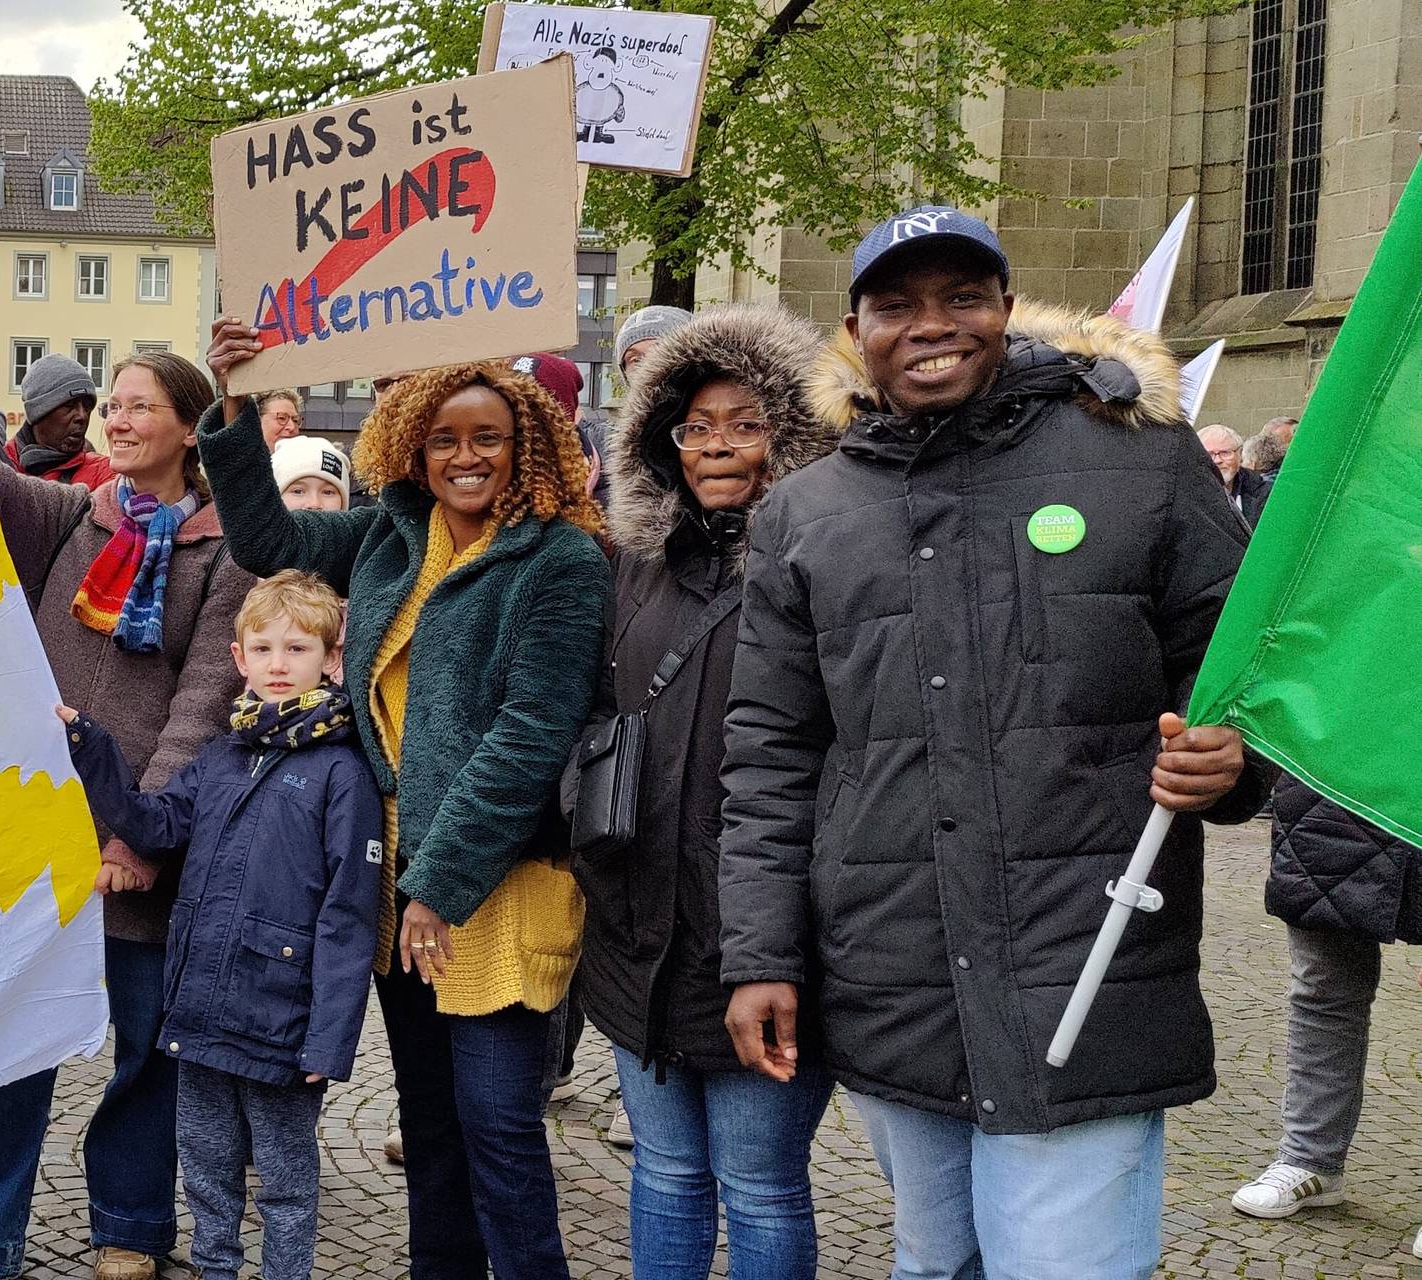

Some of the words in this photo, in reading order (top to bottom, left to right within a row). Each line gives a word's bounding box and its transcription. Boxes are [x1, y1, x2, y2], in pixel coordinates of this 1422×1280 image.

[533, 19, 563, 44] Alle
[568, 21, 616, 47] Nazis
[621, 33, 688, 57] superdoof
[247, 108, 376, 189] HASS
[412, 92, 472, 145] ist
[296, 150, 484, 252] KEINE
[253, 248, 544, 346] Alternative
[1036, 515, 1076, 526] TEAM
[1036, 524, 1076, 536] KLIMA
